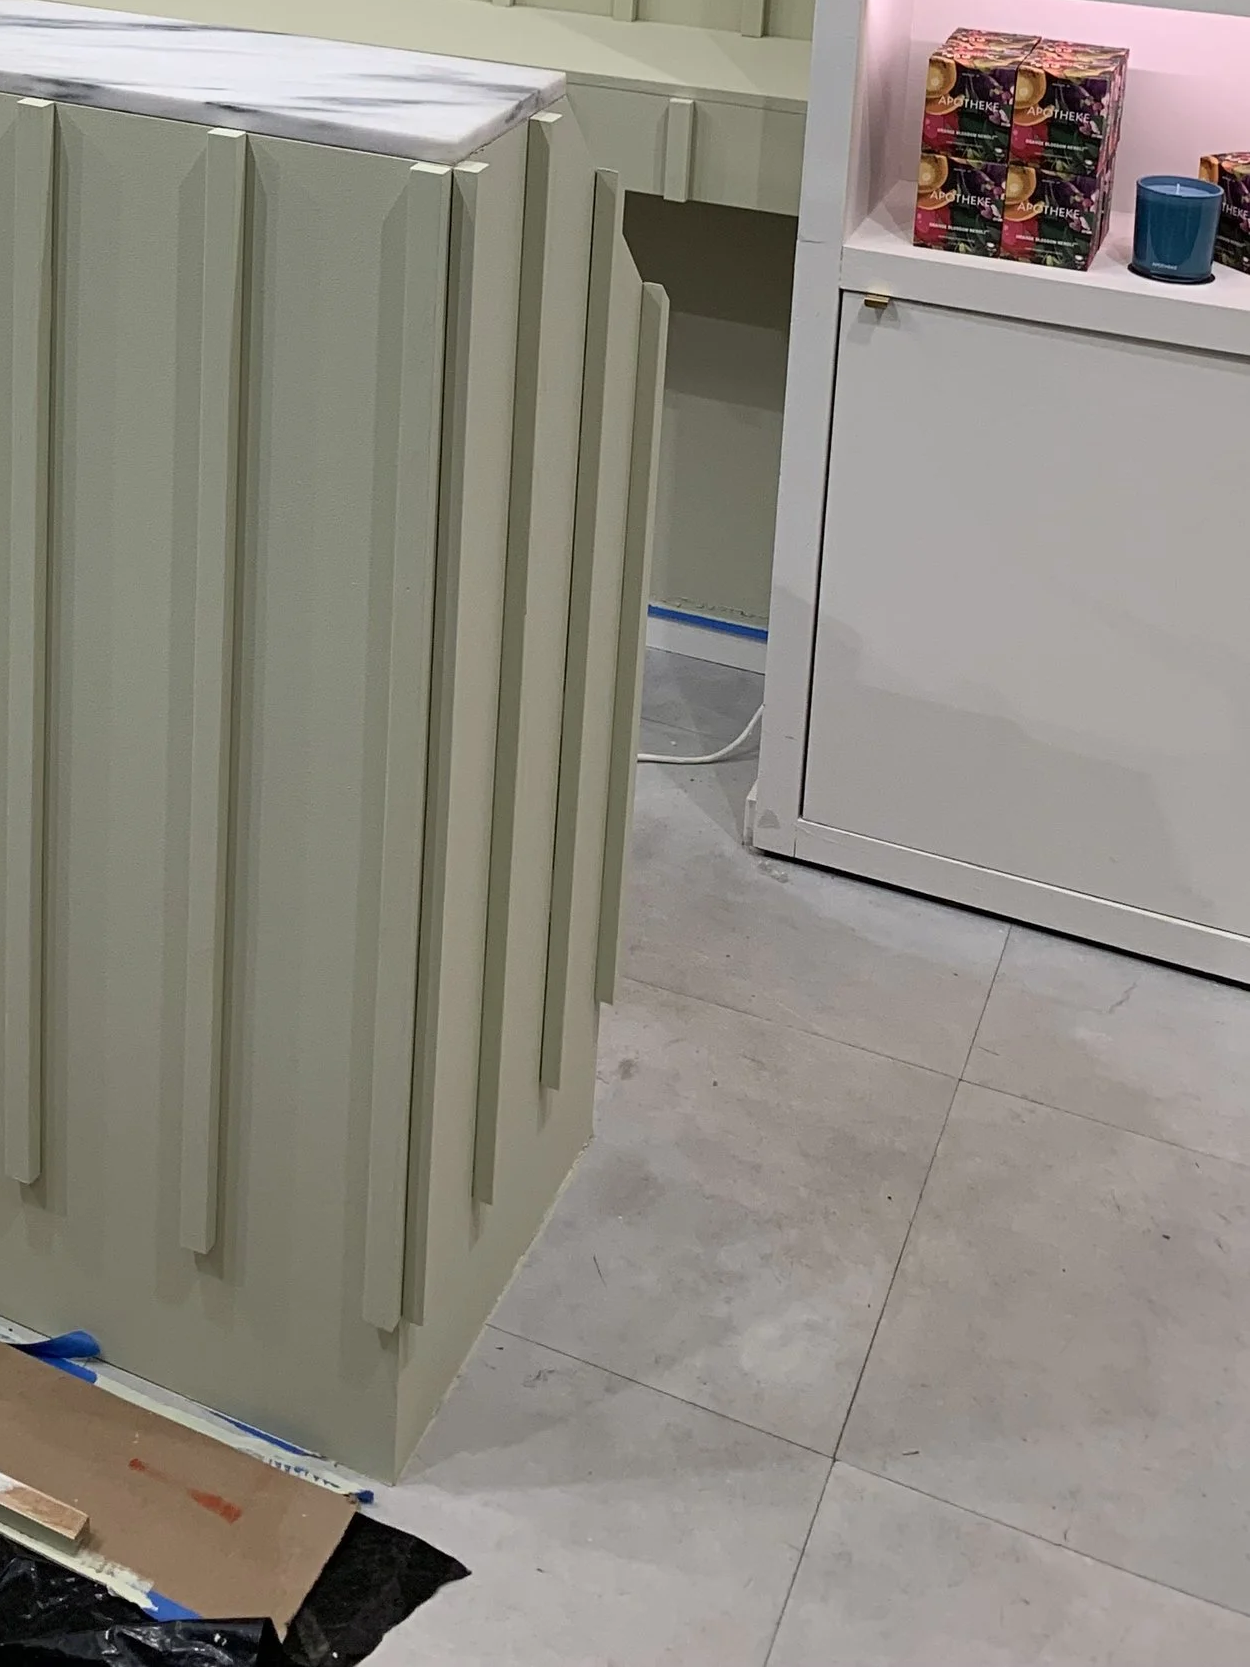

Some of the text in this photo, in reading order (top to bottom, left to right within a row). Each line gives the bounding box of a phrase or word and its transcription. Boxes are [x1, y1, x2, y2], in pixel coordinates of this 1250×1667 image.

[937, 95, 1001, 113] APOTHEKE
[1027, 106, 1091, 124] APOTHEKE
[930, 190, 993, 207] APOTHEKE
[1017, 201, 1081, 219] APOTHEKE
